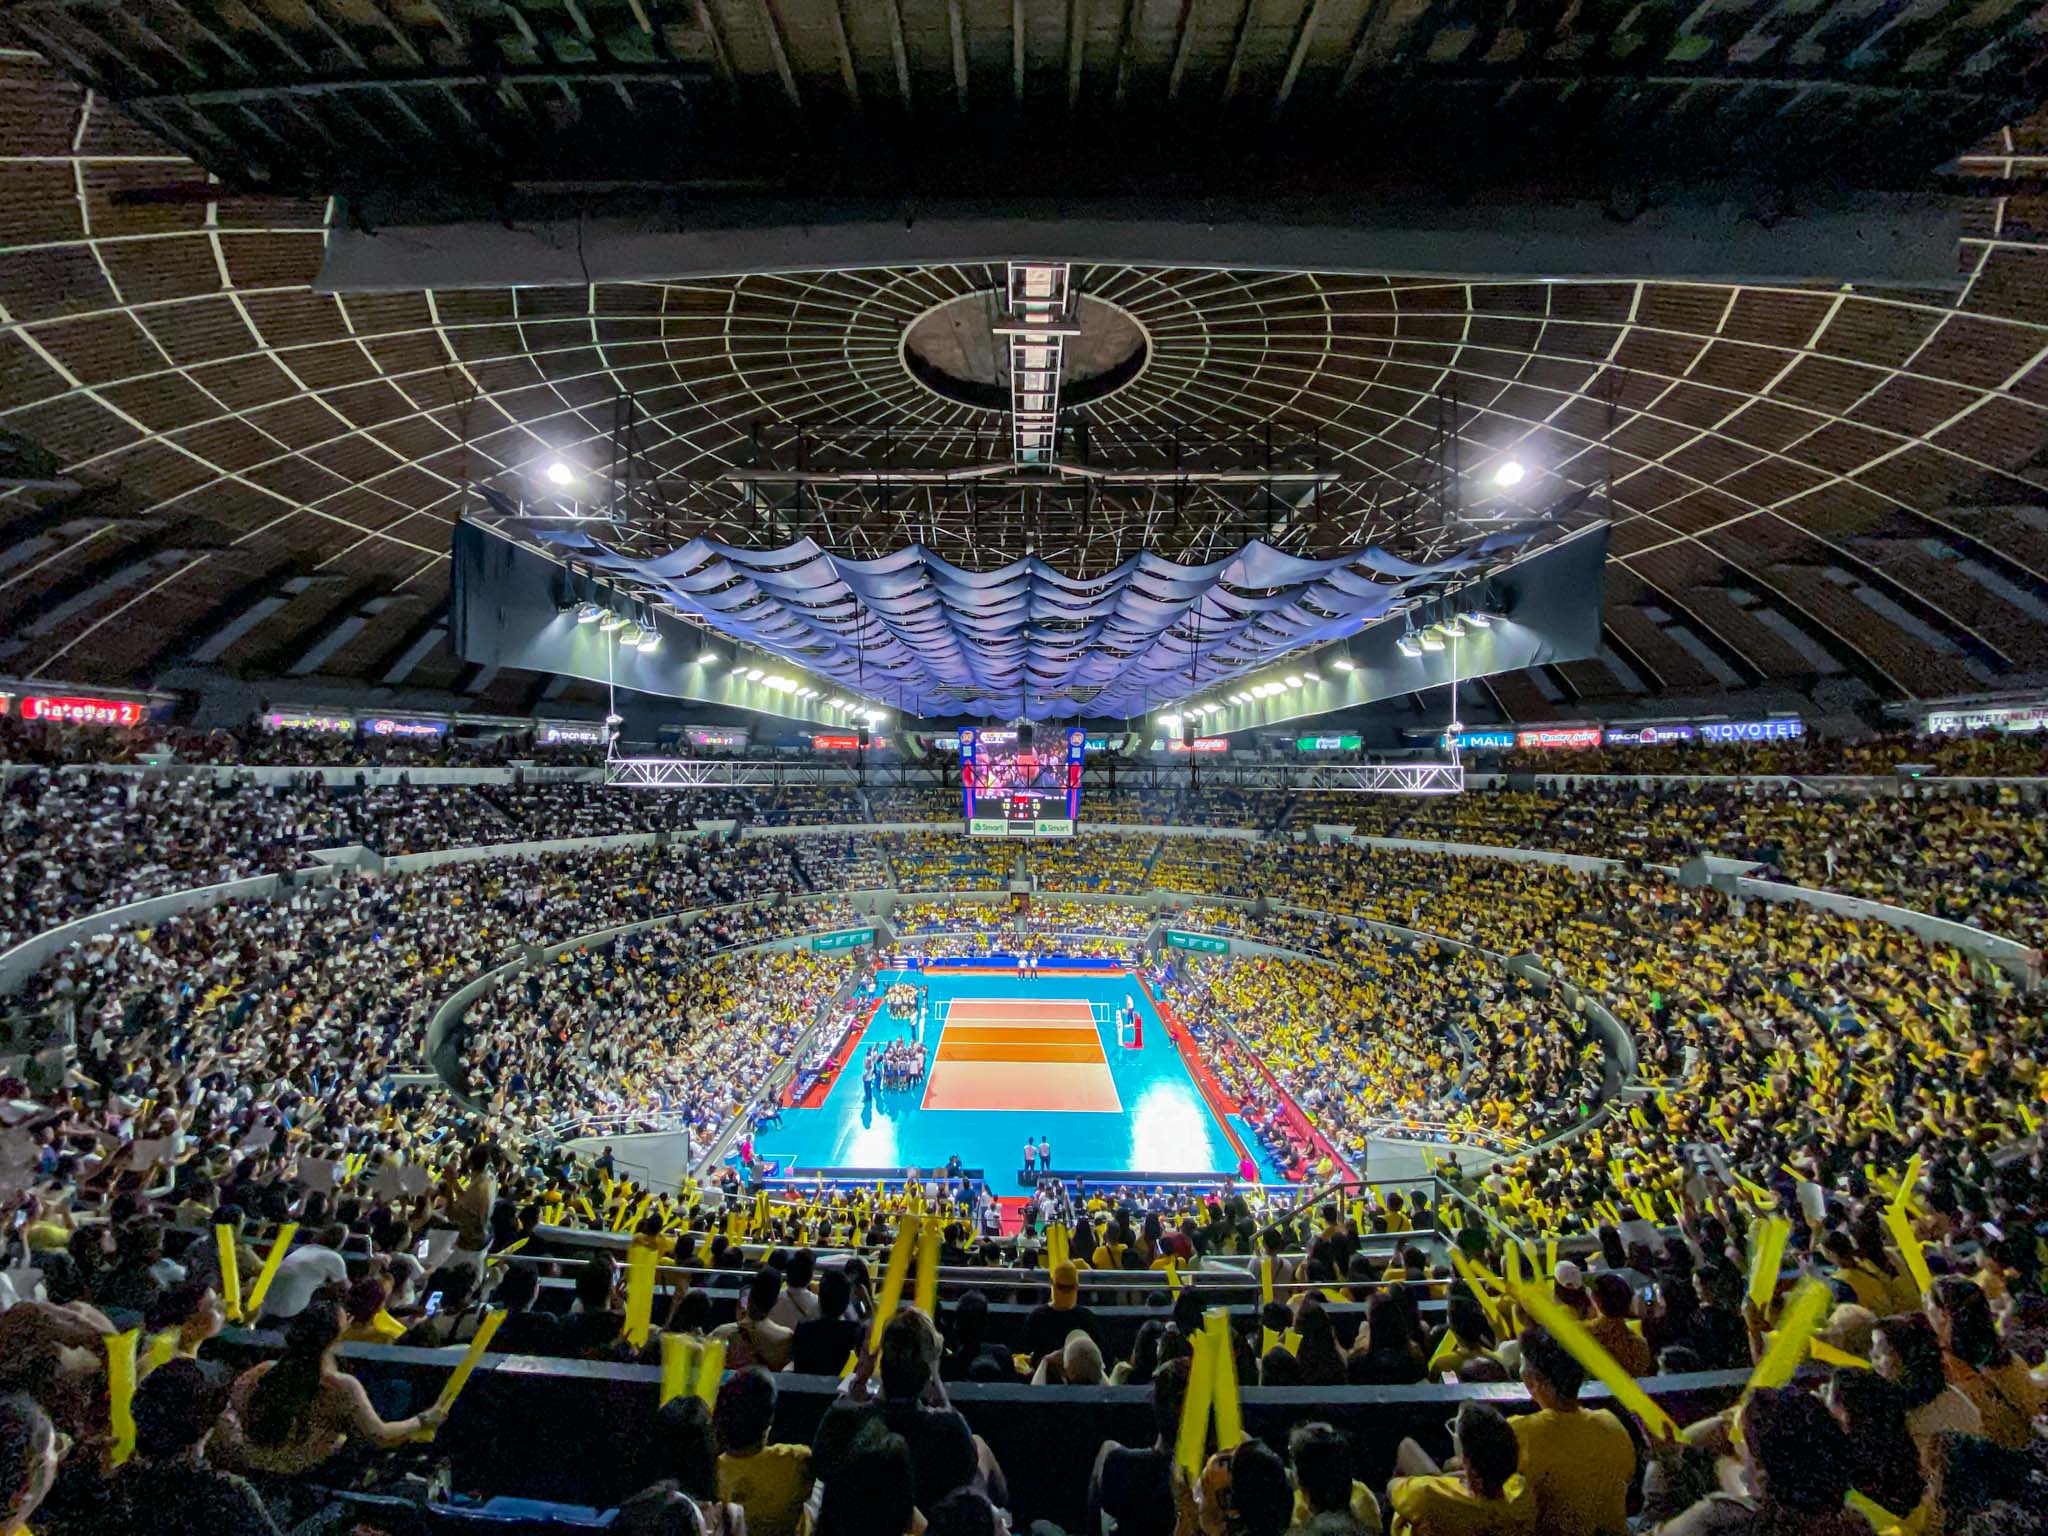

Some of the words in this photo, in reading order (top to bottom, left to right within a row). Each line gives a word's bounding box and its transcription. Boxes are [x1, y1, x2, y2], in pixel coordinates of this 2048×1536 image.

[561, 732, 579, 740] TACO
[1706, 723, 1800, 740] NOVOTEL
[1471, 736, 1513, 746] MALL
[1609, 733, 1639, 741] TACO
[982, 823, 1004, 832] Smart
[1047, 823, 1069, 832] Smart
